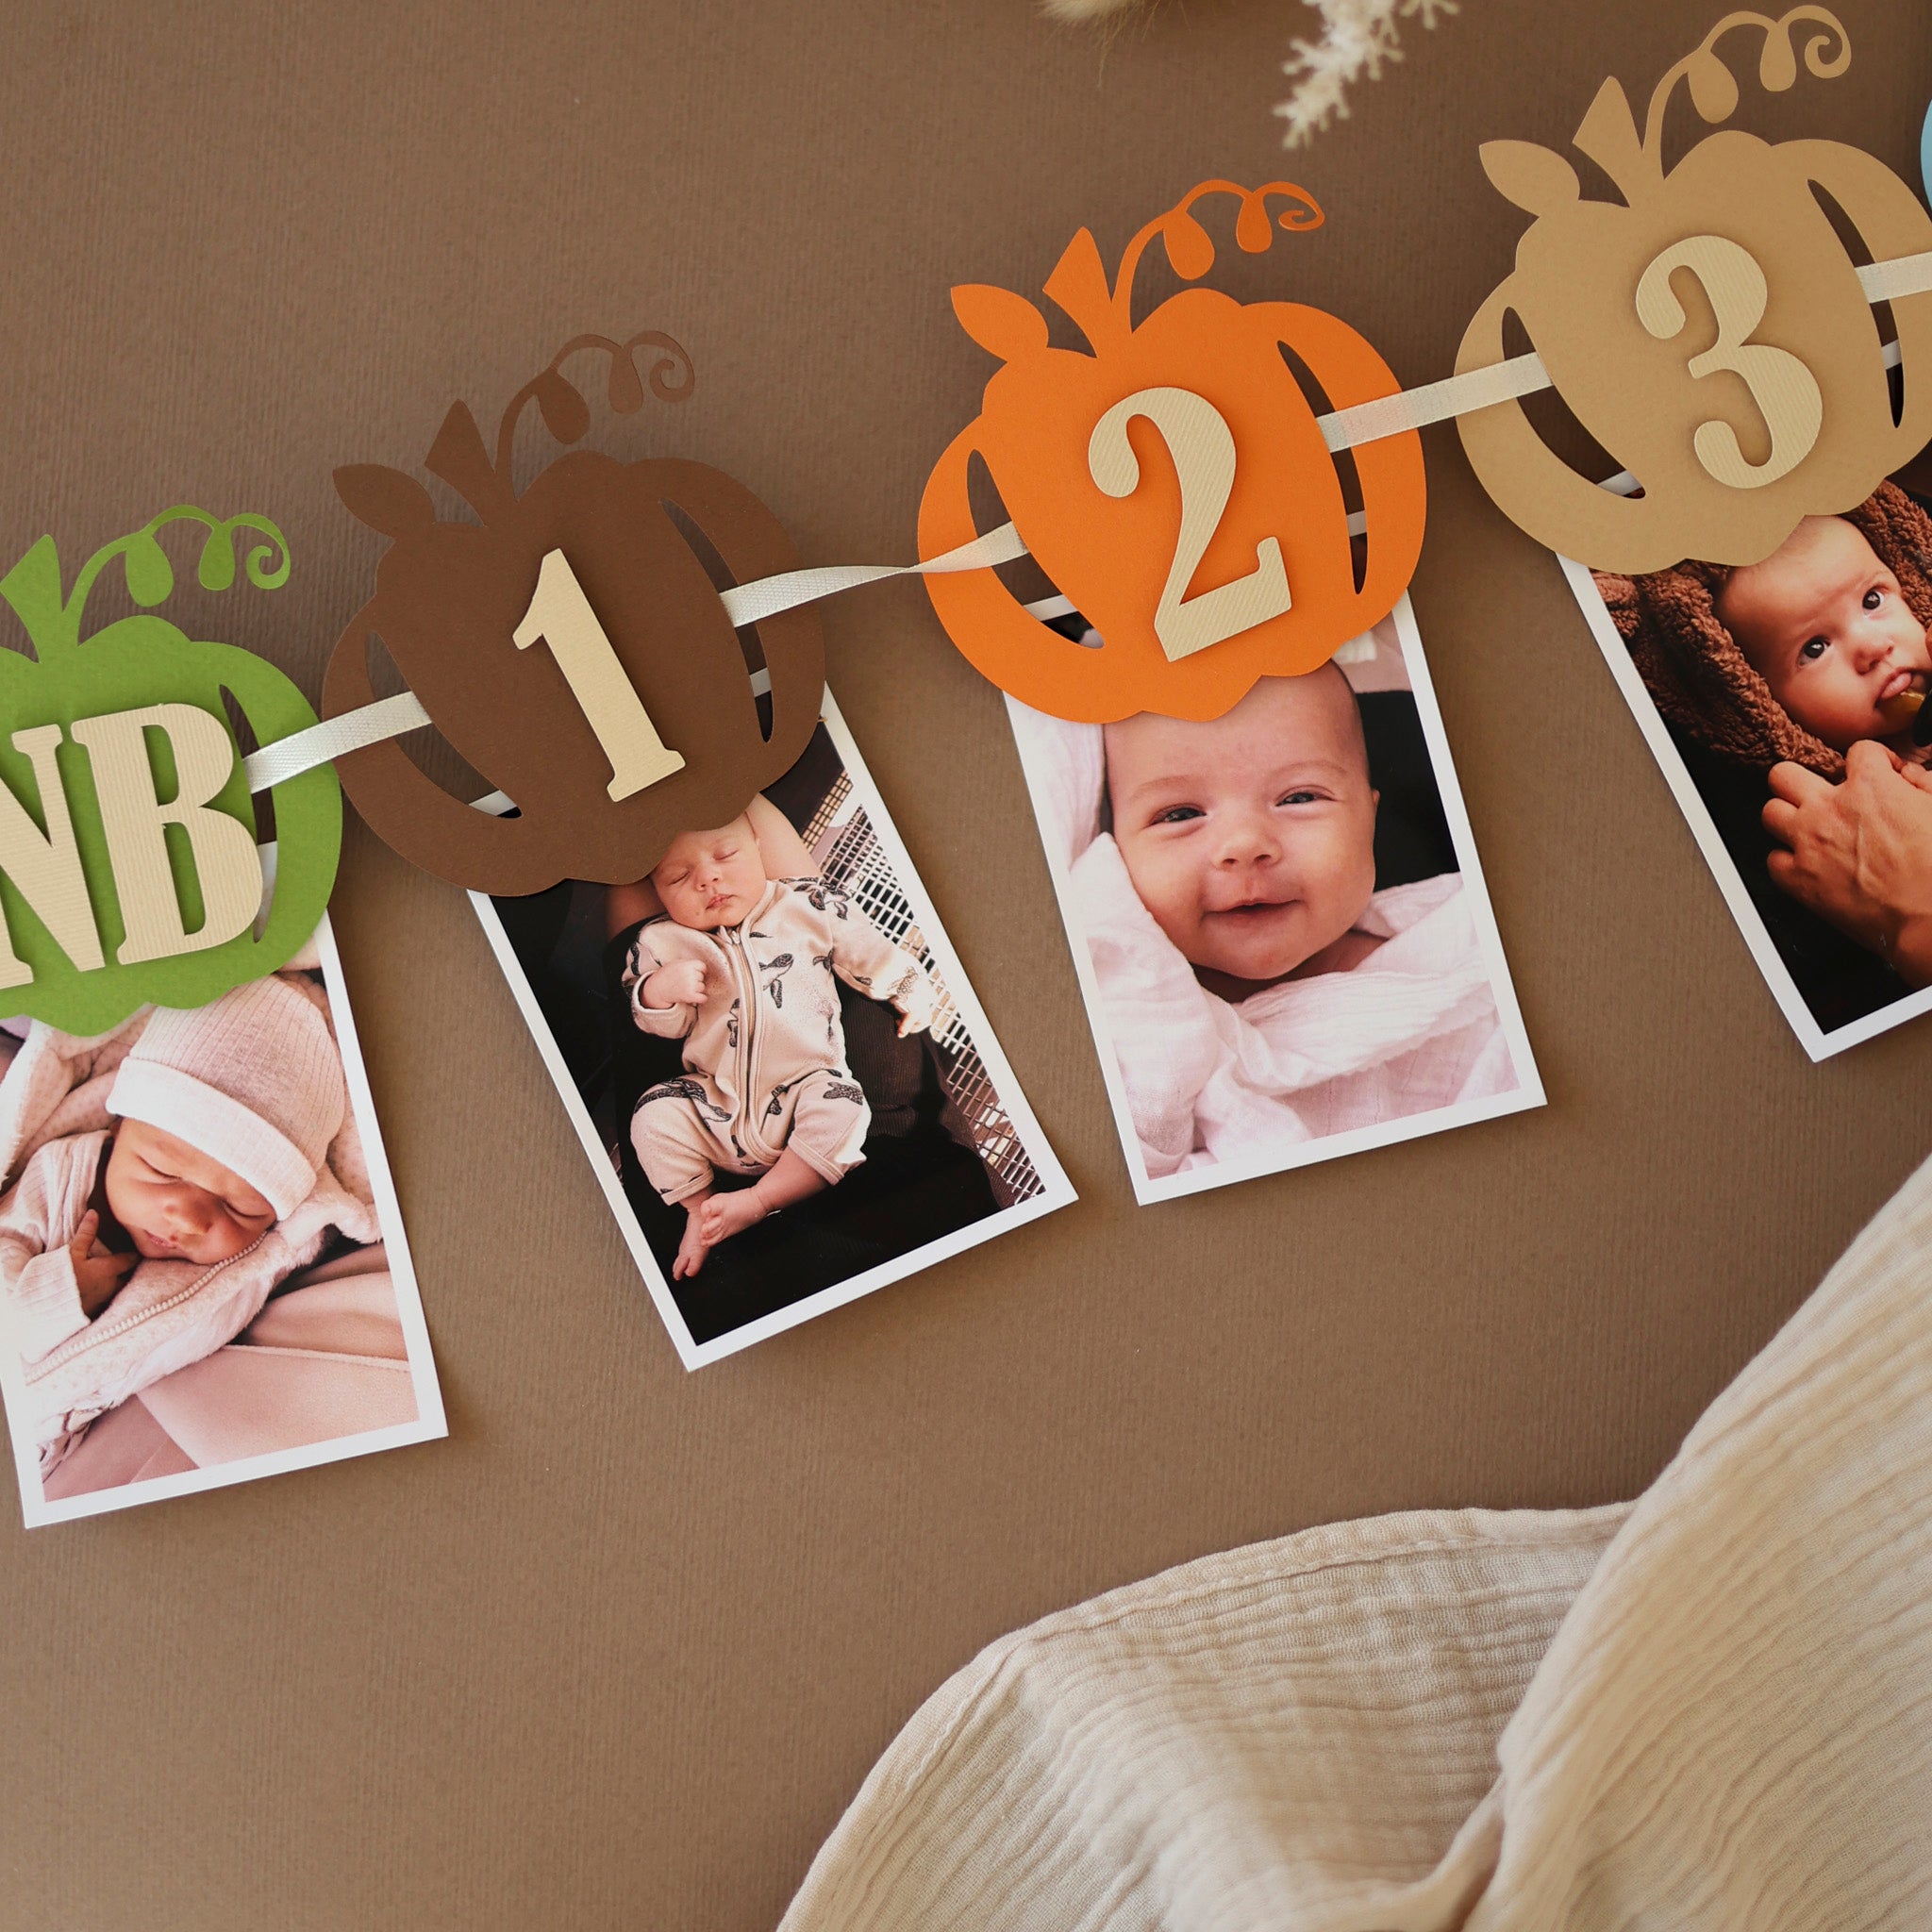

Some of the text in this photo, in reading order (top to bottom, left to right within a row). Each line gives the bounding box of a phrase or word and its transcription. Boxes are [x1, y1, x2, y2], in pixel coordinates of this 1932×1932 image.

[1635, 235, 1823, 489] 3
[1089, 387, 1292, 662] 2
[512, 548, 686, 802] 1
[0, 703, 263, 990] NB
